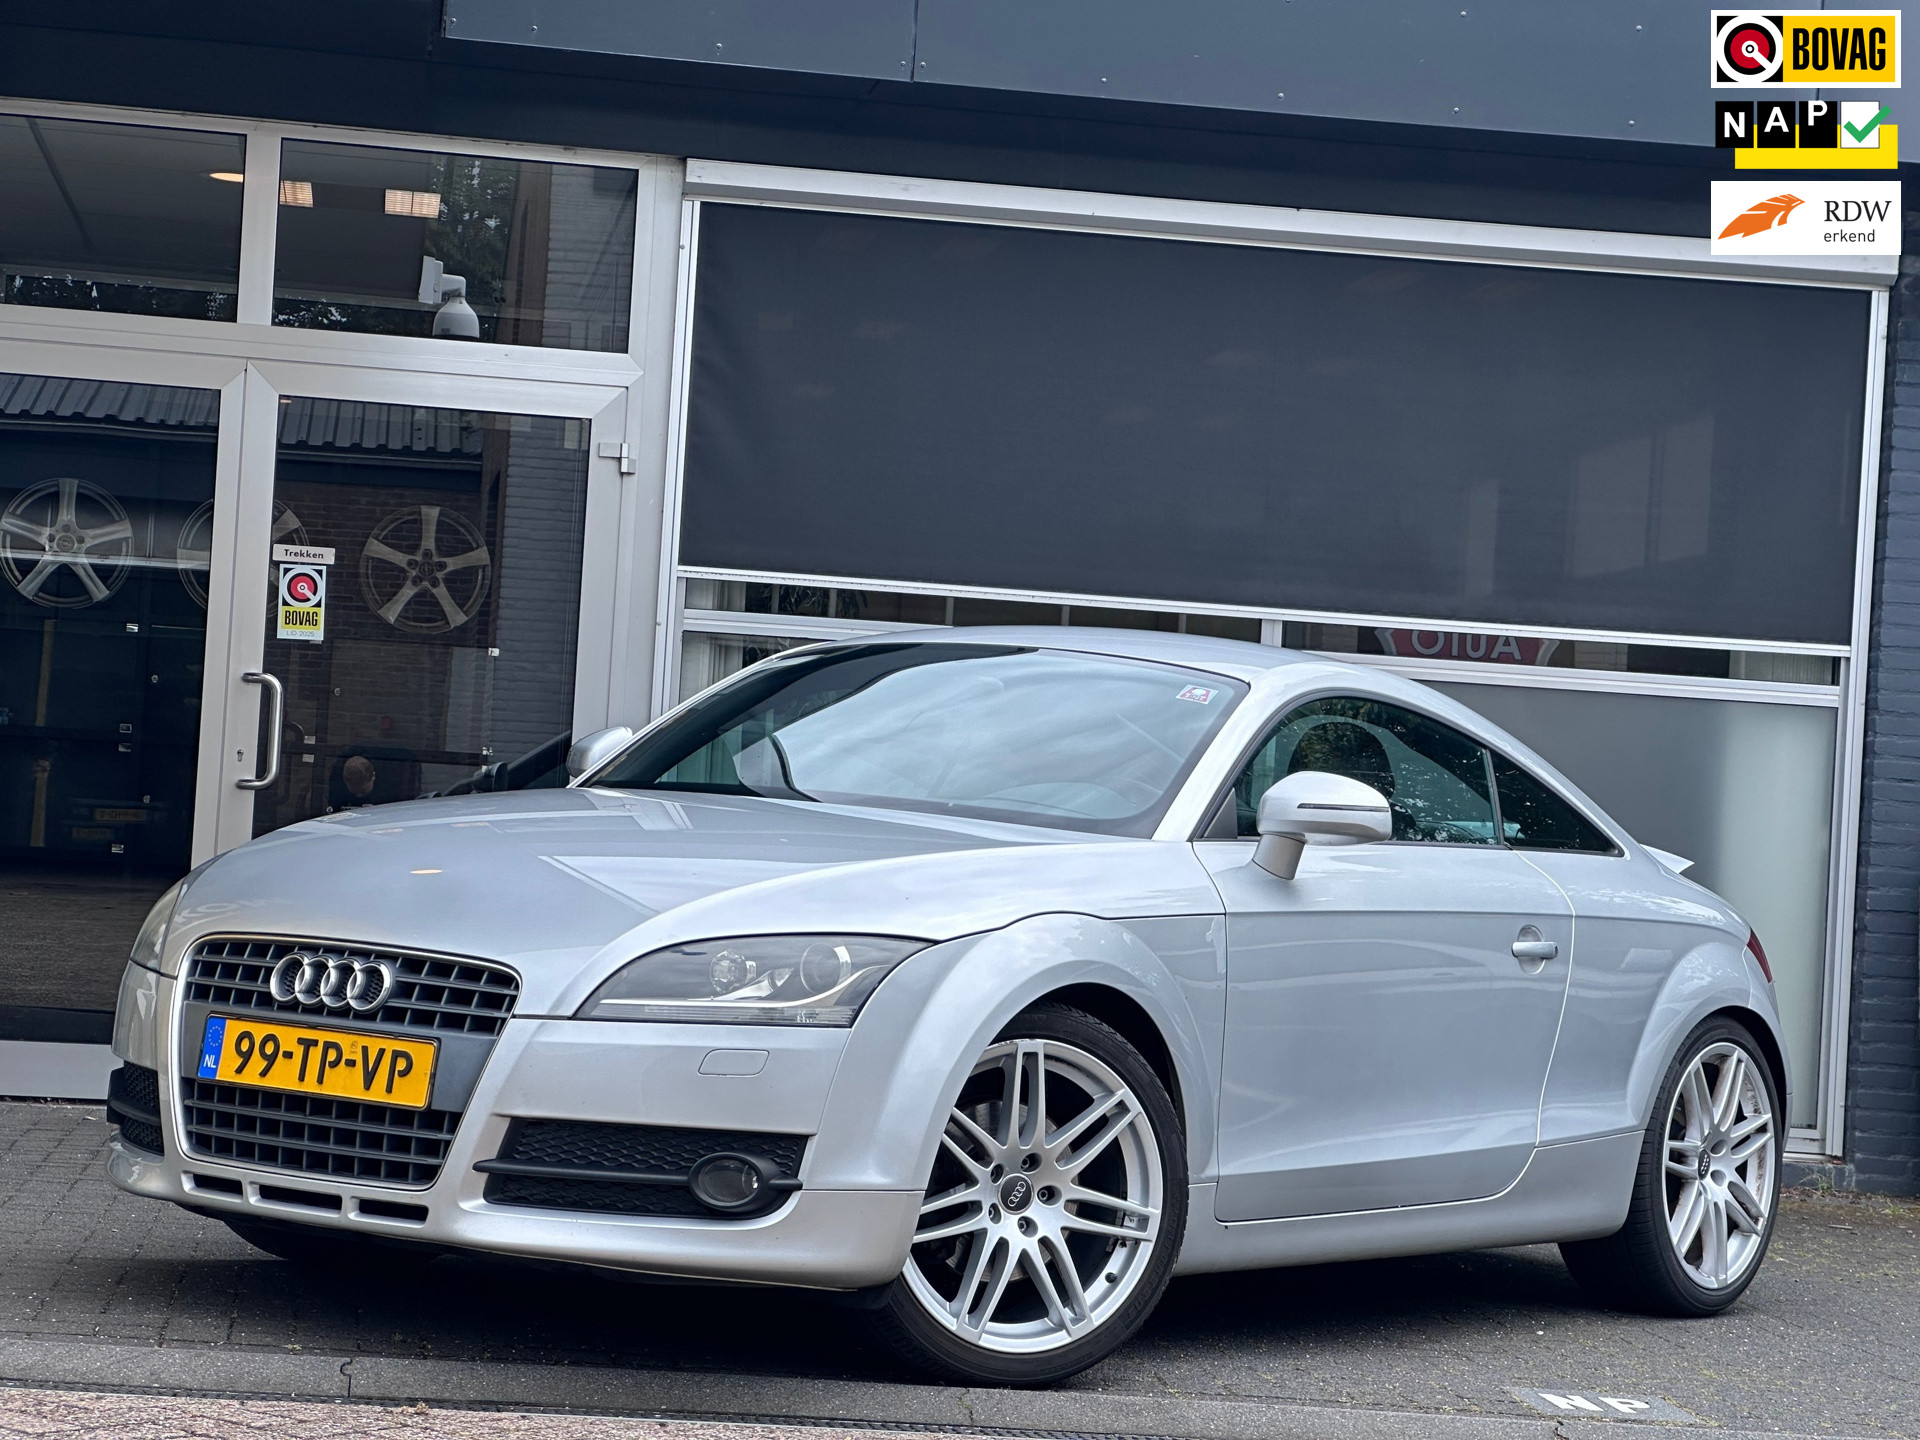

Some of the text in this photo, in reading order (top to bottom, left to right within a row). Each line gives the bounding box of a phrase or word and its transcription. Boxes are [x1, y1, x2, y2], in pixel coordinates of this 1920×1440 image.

[284, 548, 324, 559] Trekken
[284, 610, 318, 627] BOVAG
[203, 1053, 217, 1068] NL
[234, 1030, 414, 1094] 99-TP-VP
[1538, 1393, 1651, 1414] NP
